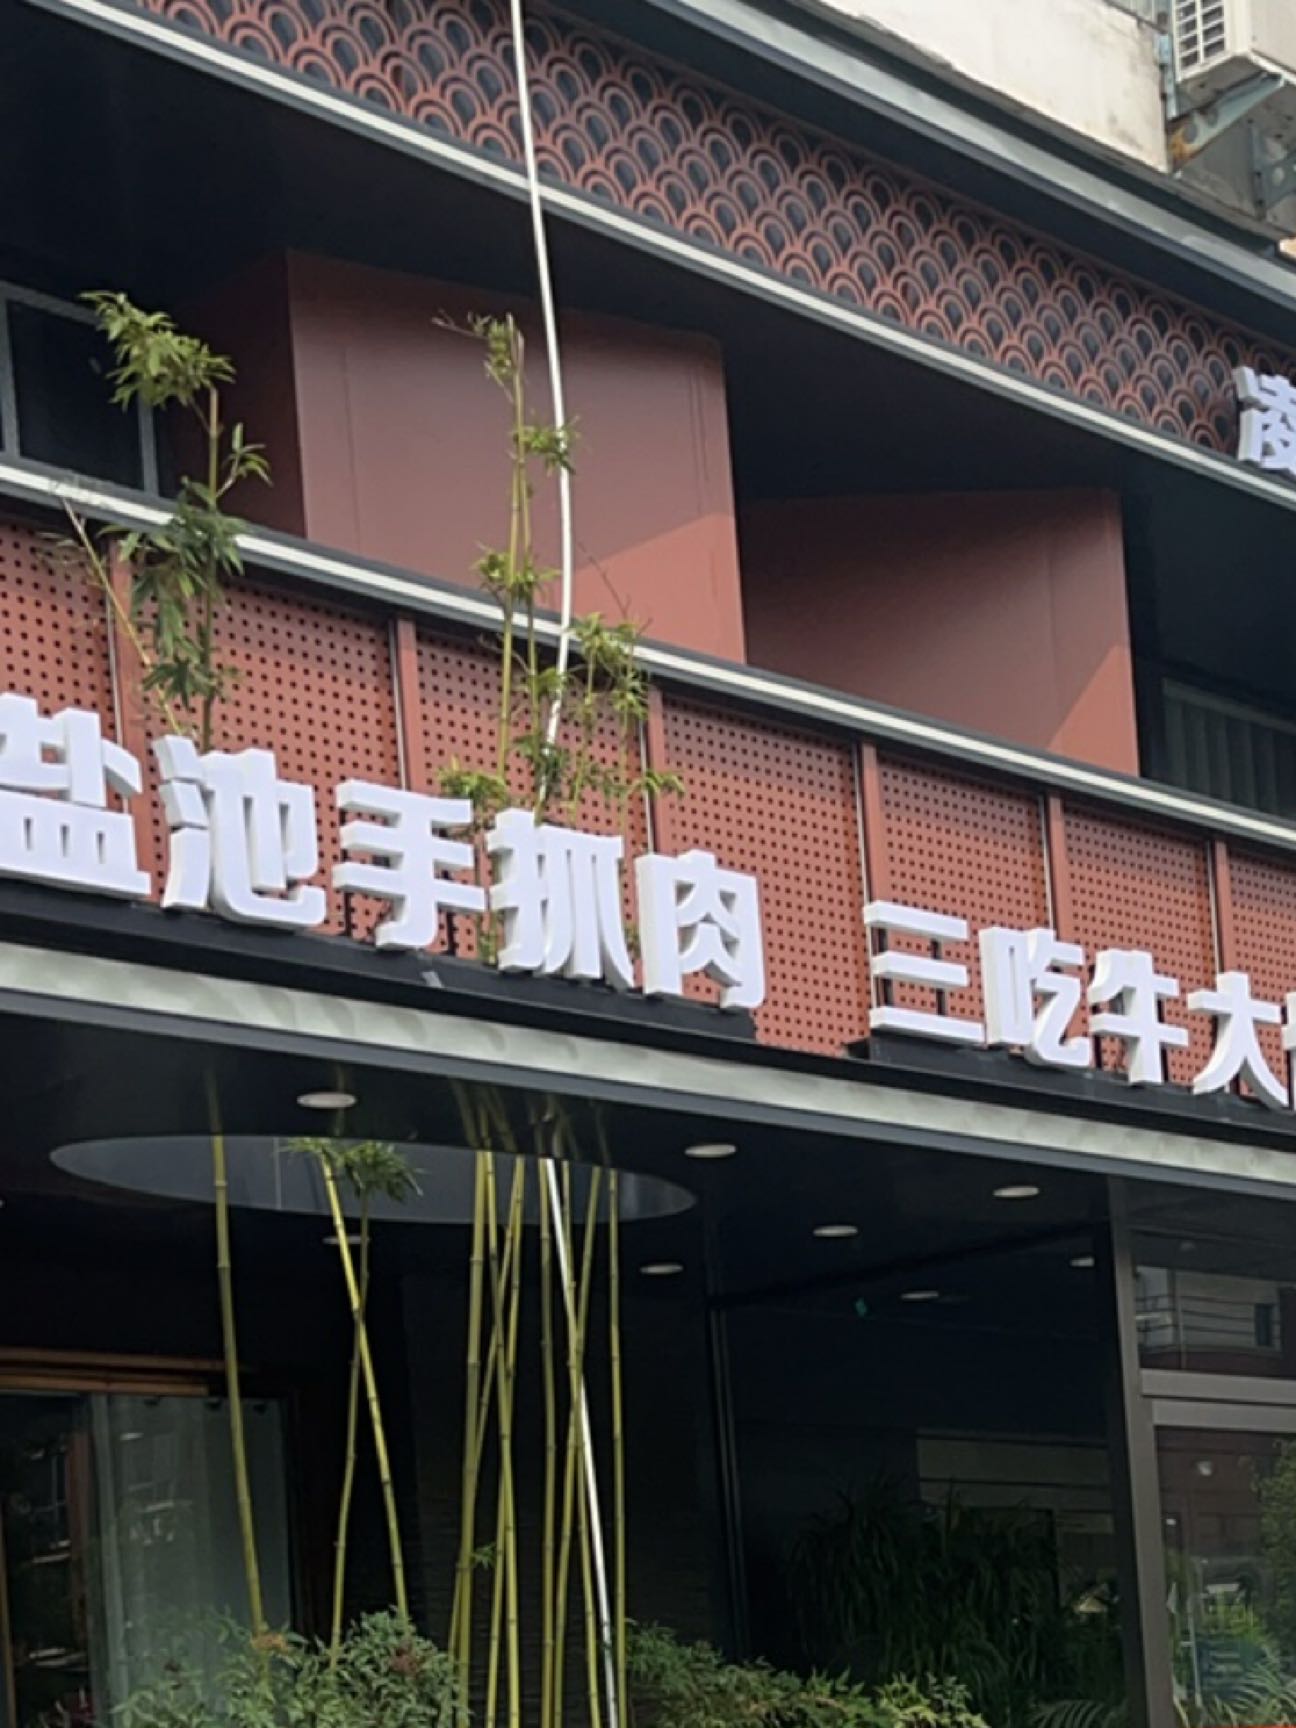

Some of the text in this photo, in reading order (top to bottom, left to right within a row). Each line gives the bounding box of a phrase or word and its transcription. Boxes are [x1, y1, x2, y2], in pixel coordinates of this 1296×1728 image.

[0, 692, 766, 1009] 盐池手抓肉
